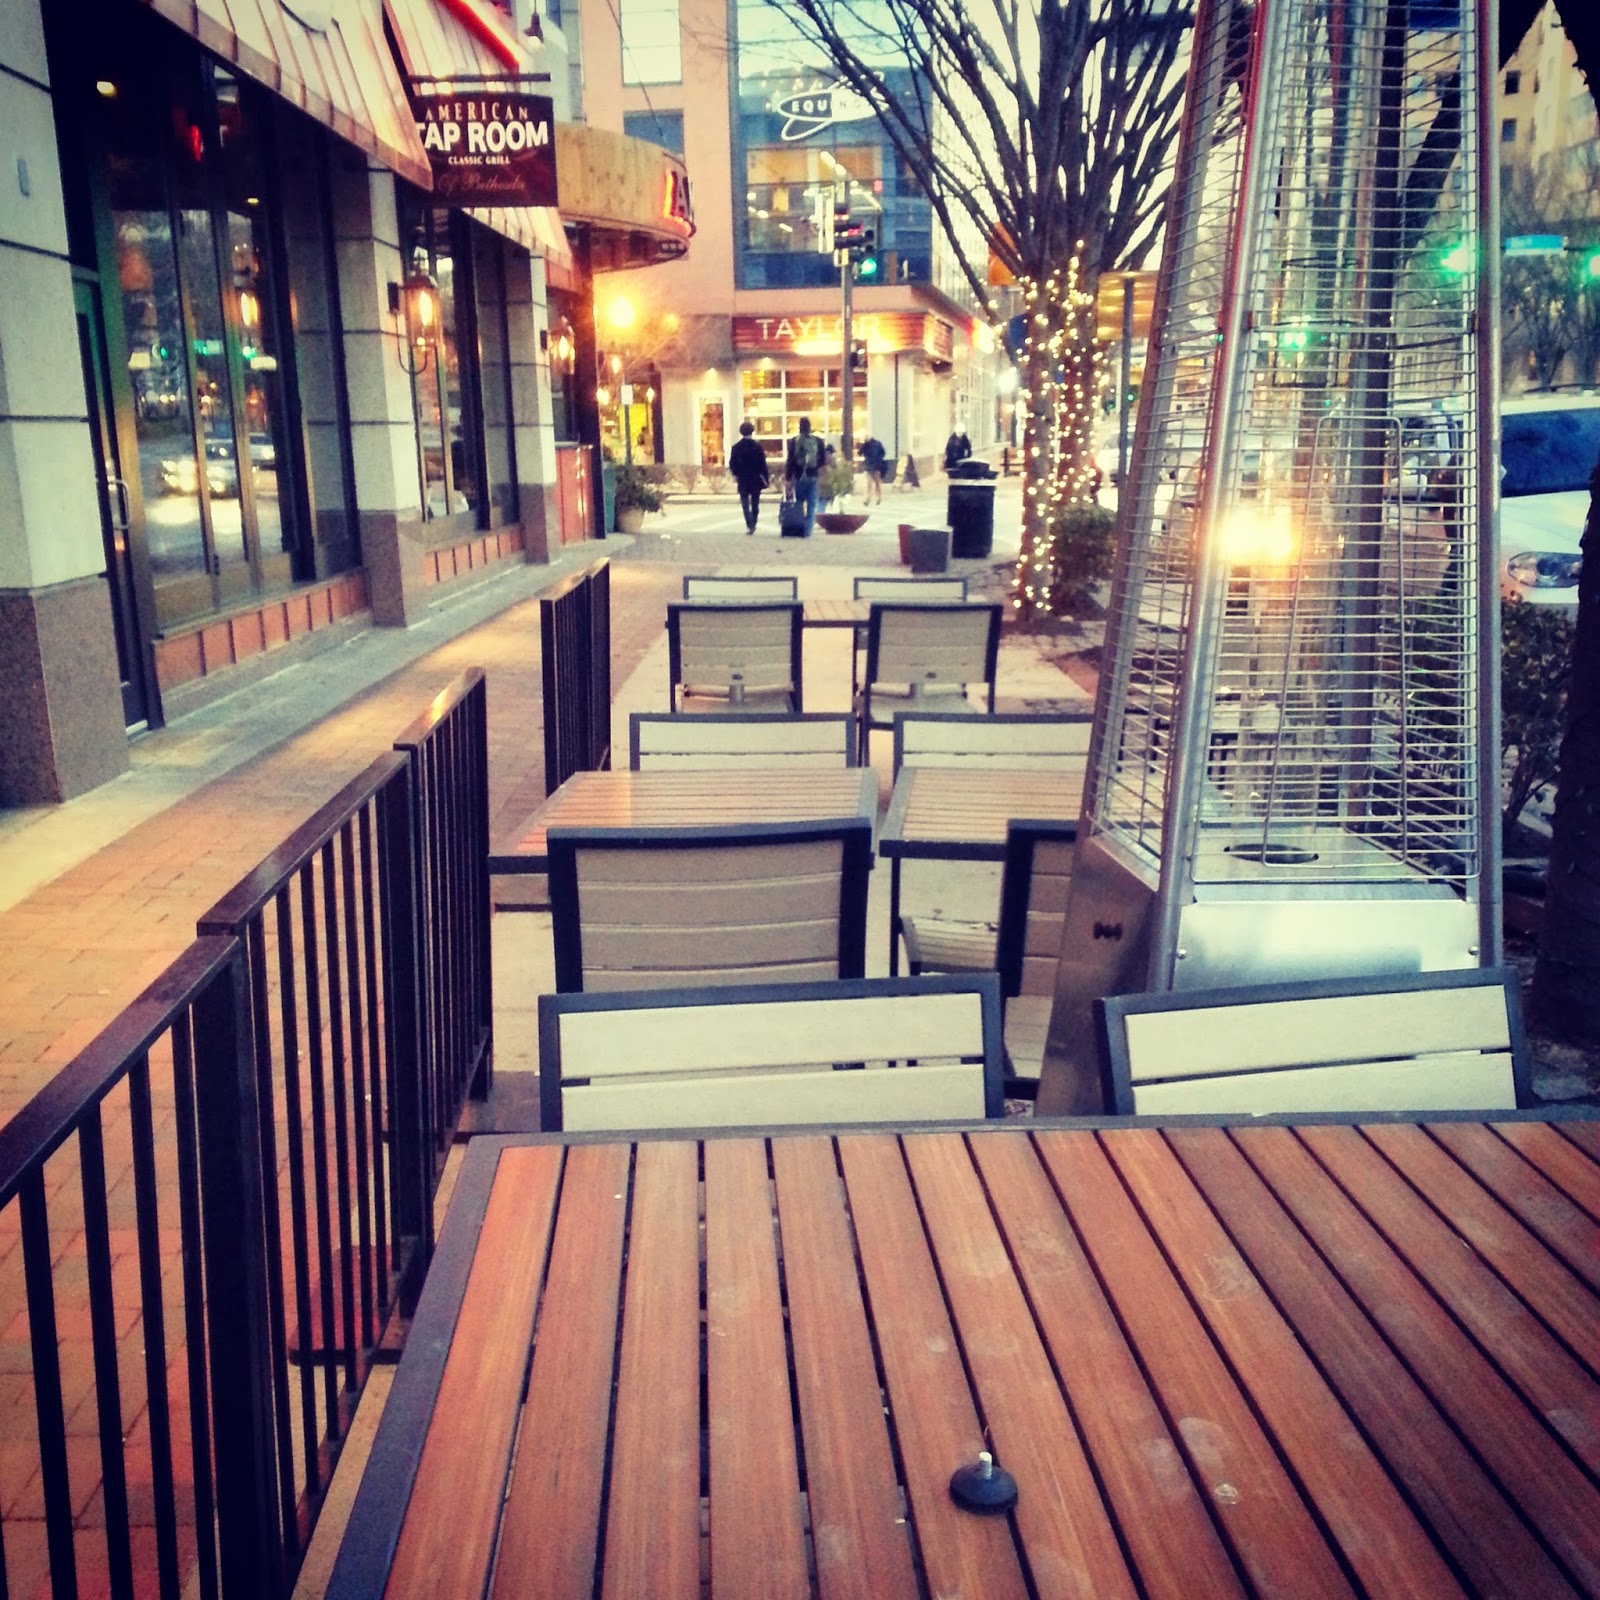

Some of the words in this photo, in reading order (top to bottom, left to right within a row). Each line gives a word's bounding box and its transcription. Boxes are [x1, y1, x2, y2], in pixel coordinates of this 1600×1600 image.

[425, 101, 528, 121] AMERICAN
[467, 120, 549, 153] ROOM
[448, 155, 483, 165] CLASSIC
[485, 155, 511, 165] GRILL
